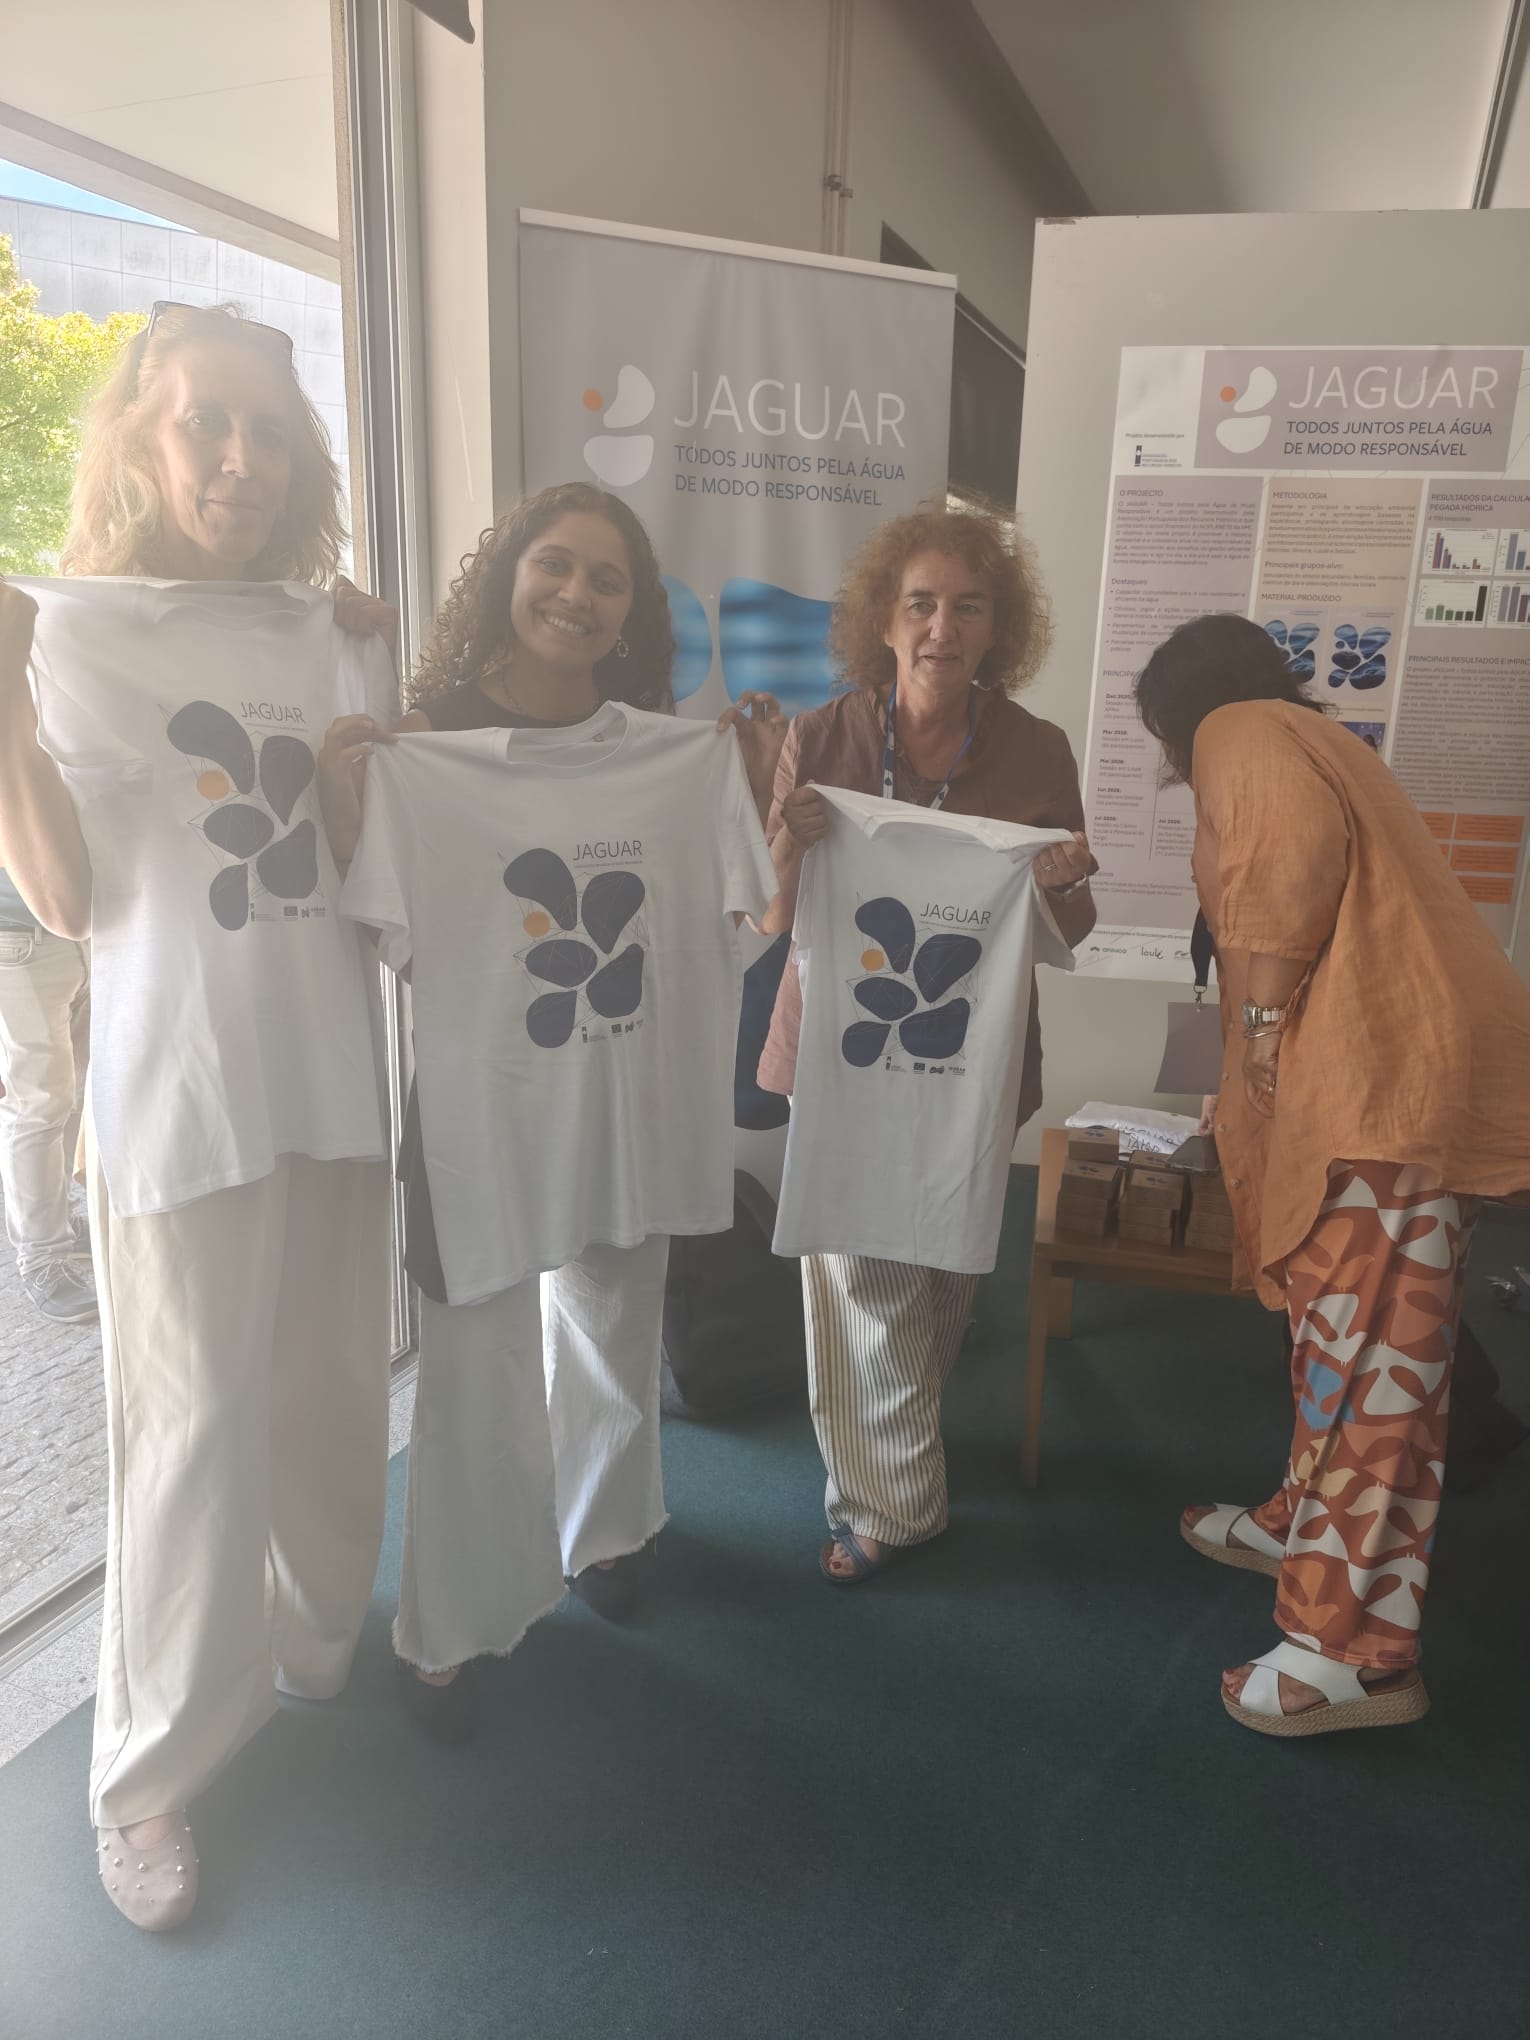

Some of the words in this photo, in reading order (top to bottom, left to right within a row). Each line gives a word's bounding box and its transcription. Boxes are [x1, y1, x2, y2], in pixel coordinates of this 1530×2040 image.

[1288, 365, 1500, 410] JAGUAR
[673, 371, 906, 448] JAGUAR
[1286, 420, 1338, 435] TODOS
[1341, 421, 1405, 435] JUNTOS
[1408, 421, 1446, 435] PELA
[1449, 416, 1493, 435] ÁGUA
[1283, 442, 1303, 456] DE
[1306, 442, 1356, 456] MODO
[1360, 437, 1467, 457] RESPONSÁVEL
[673, 444, 736, 468] TODOS
[741, 451, 811, 473] JUNTOS
[817, 457, 857, 477] PELA
[860, 455, 905, 481] ÁGUA
[674, 474, 697, 492] DE
[701, 476, 759, 497] MODO
[764, 481, 882, 506] RESPONSÁVEL
[1126, 489, 1164, 497] PROJECTO
[1272, 491, 1328, 500] METODOLOGIA
[1431, 494, 1480, 502] RESULTADOS
[1481, 494, 1493, 502] DA
[1494, 494, 1530, 502] CALCULA
[1430, 503, 1461, 511] PEGADA
[1261, 593, 1296, 602] MATERIAL
[1297, 593, 1342, 602] PRODUZIDO
[240, 701, 307, 724] JAGUAR
[572, 839, 643, 861] JAGUAR
[920, 903, 992, 925] JAGUAR
